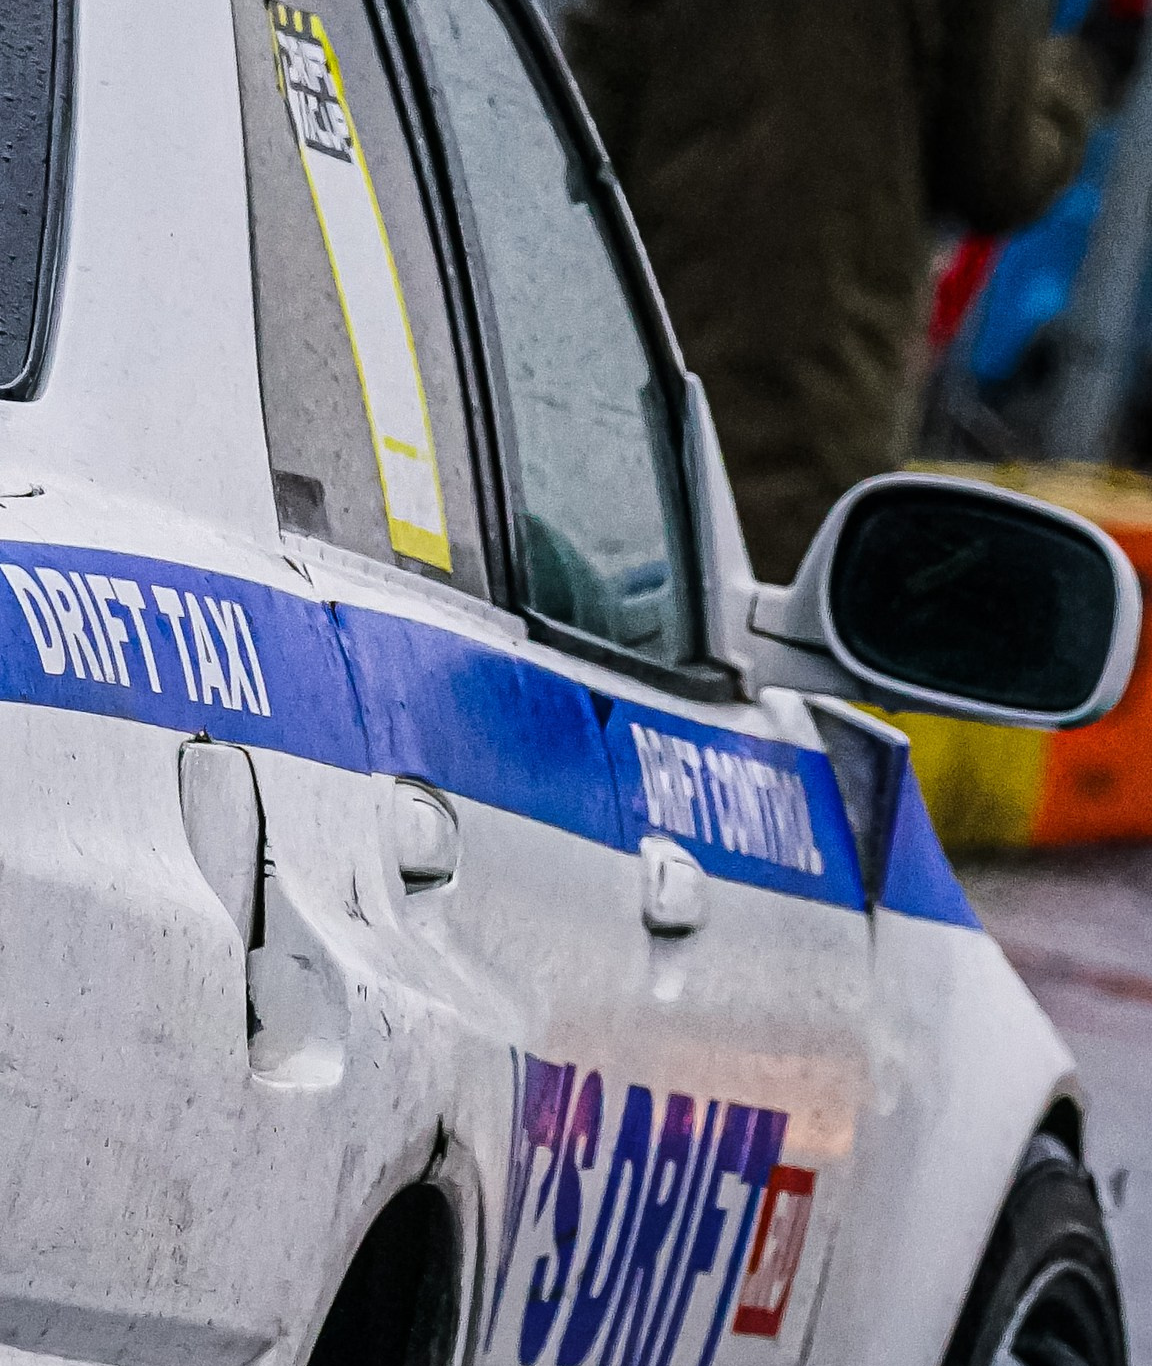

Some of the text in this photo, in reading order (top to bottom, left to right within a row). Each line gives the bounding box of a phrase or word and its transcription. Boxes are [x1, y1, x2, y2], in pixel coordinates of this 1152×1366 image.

[0, 563, 272, 718] DRIFT TAXI
[629, 721, 713, 845] DRIFT
